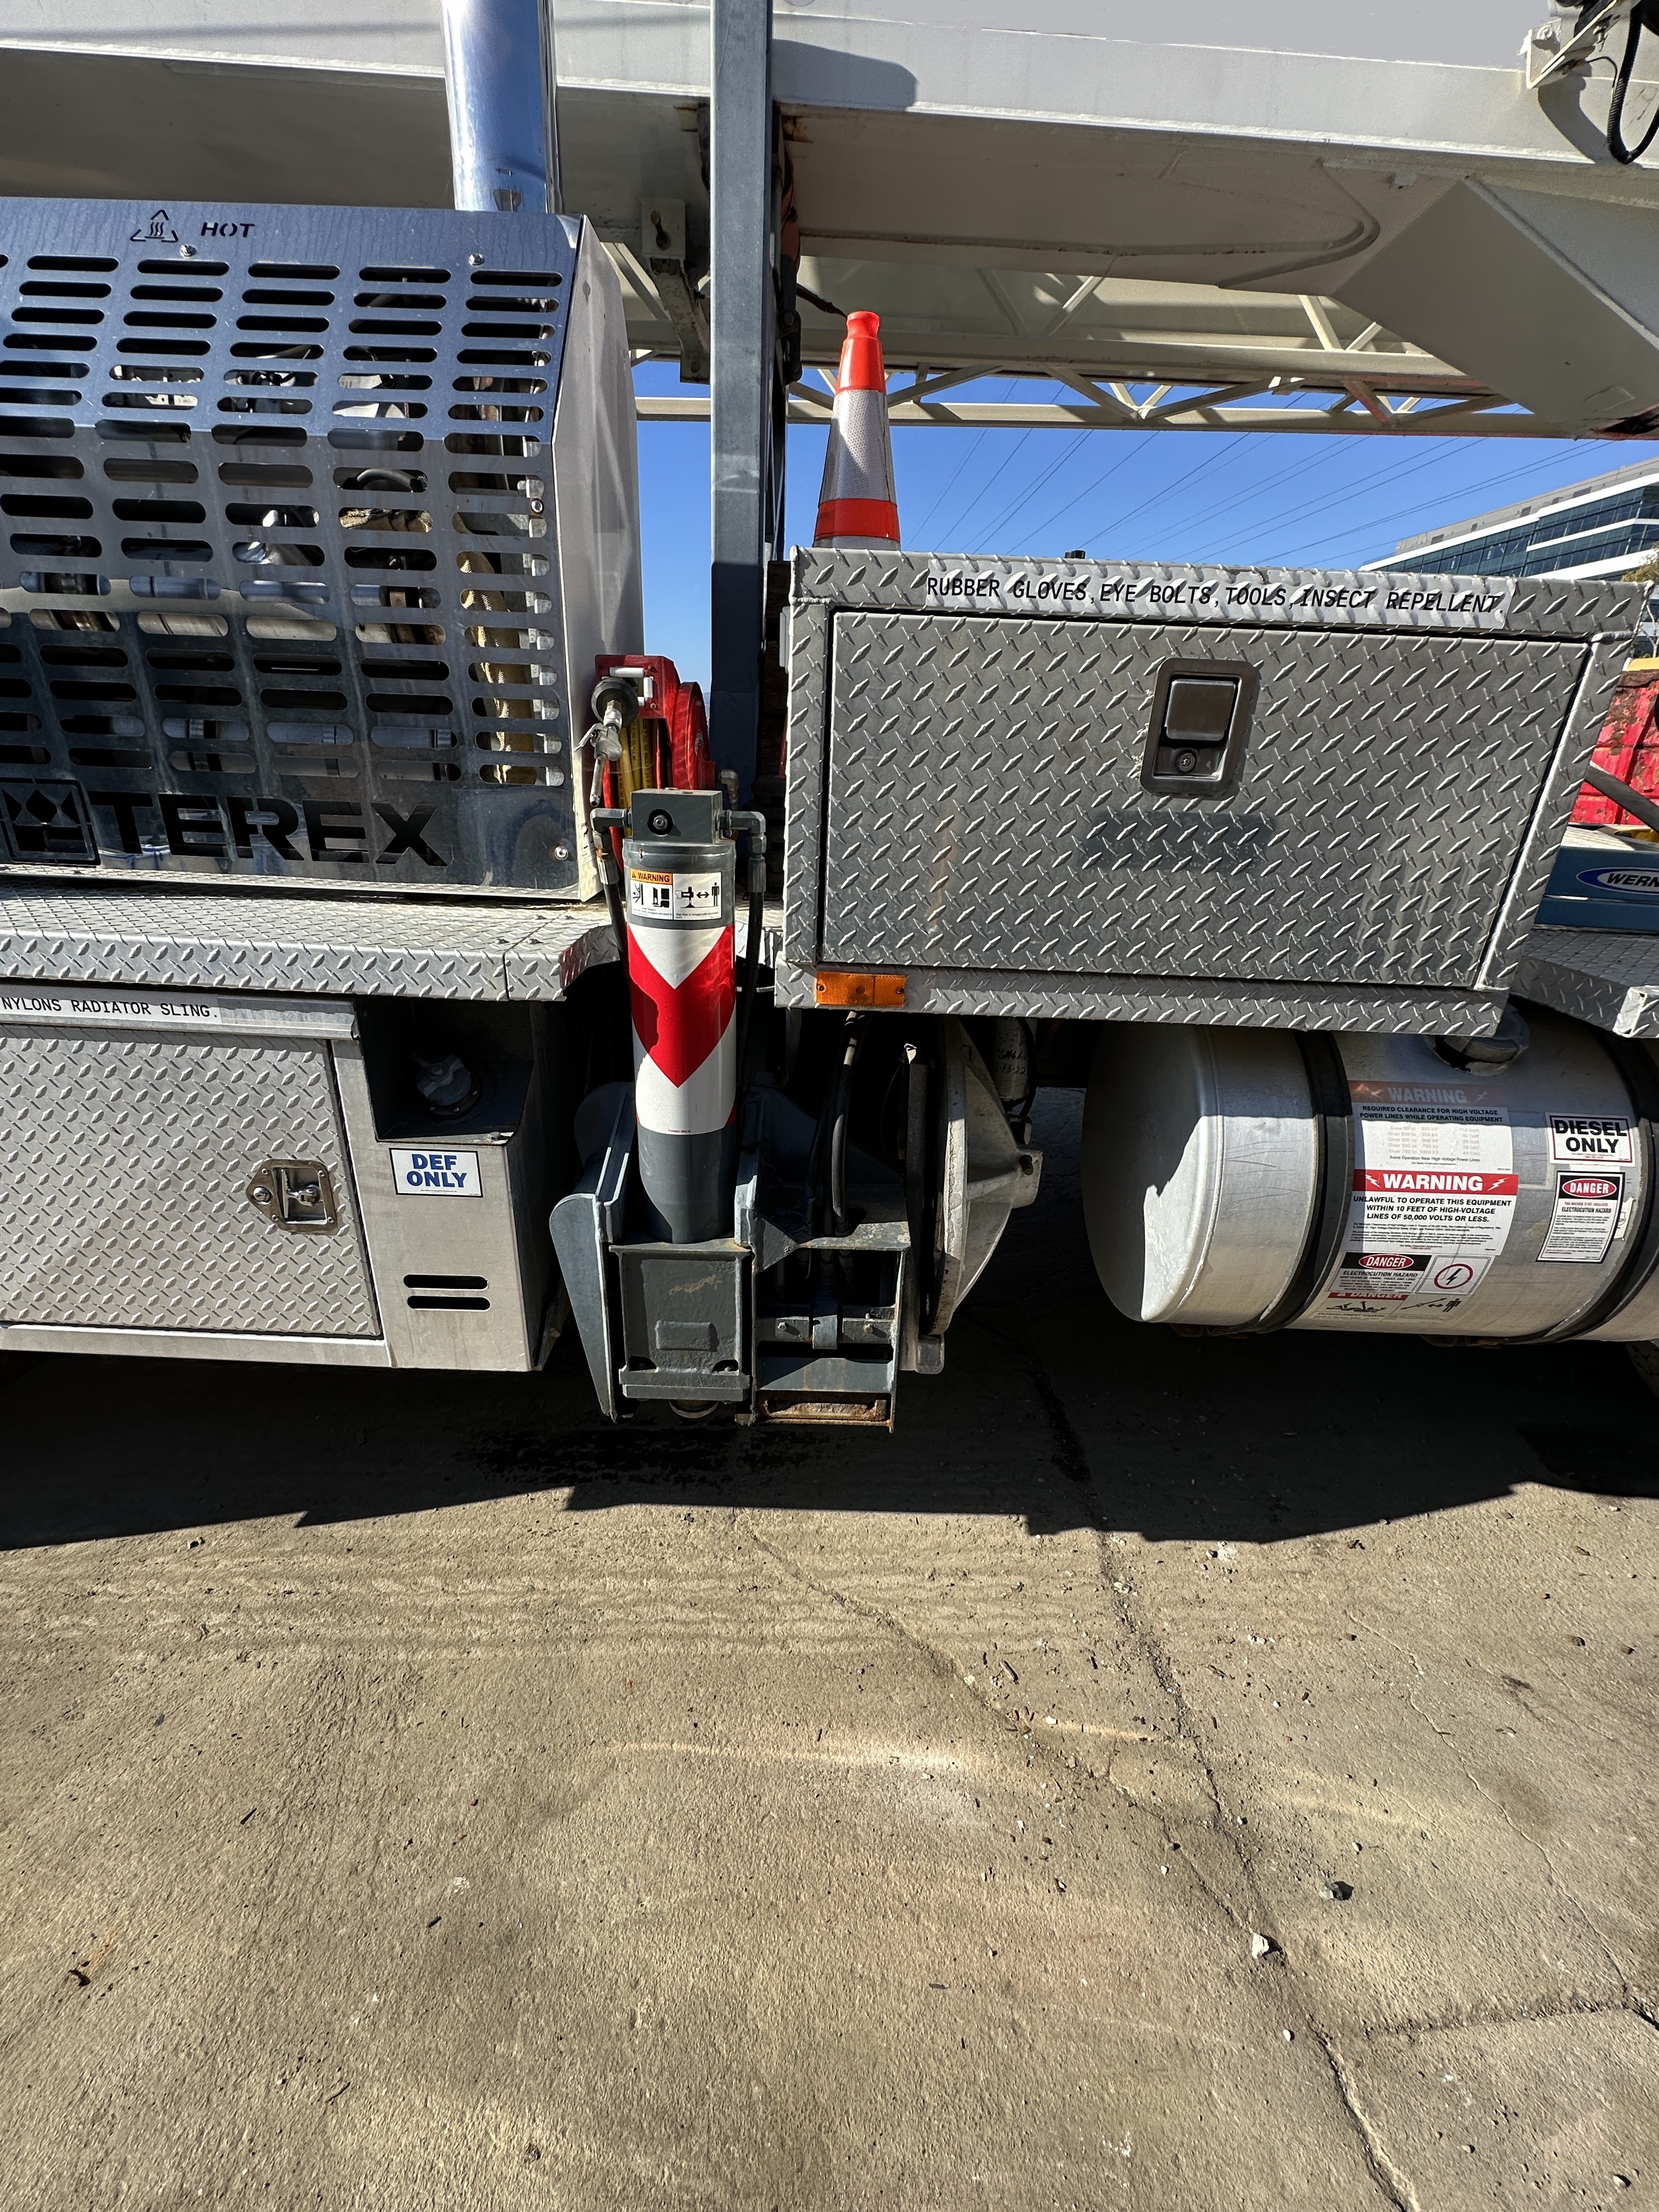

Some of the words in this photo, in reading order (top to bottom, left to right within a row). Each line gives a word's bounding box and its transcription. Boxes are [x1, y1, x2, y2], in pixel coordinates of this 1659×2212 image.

[201, 222, 255, 238] HOT
[927, 577, 1000, 597] RUBBER
[1013, 579, 1094, 605] GLOVES,
[1099, 584, 1136, 602] EYE
[1150, 584, 1218, 609] BOLTS,
[1225, 586, 1293, 610] TOOLS,
[1300, 588, 1376, 610] INSECT
[1385, 591, 1504, 614] REPELLENT.
[88, 791, 449, 867] TEREX
[638, 872, 670, 882] WARNING
[1, 997, 62, 1012] NYLONS
[71, 999, 151, 1015] RADIATOR
[161, 1003, 218, 1018] SLING.
[1387, 1087, 1468, 1104] WARNING
[1554, 1119, 1627, 1137] DIESEL
[1566, 1137, 1620, 1153] ONLY
[411, 1154, 457, 1171] DEF
[407, 1171, 467, 1188] ONLY
[1383, 1173, 1483, 1192] WARNING
[1570, 1182, 1610, 1194] DANGER
[1366, 1256, 1407, 1267] DANGER
